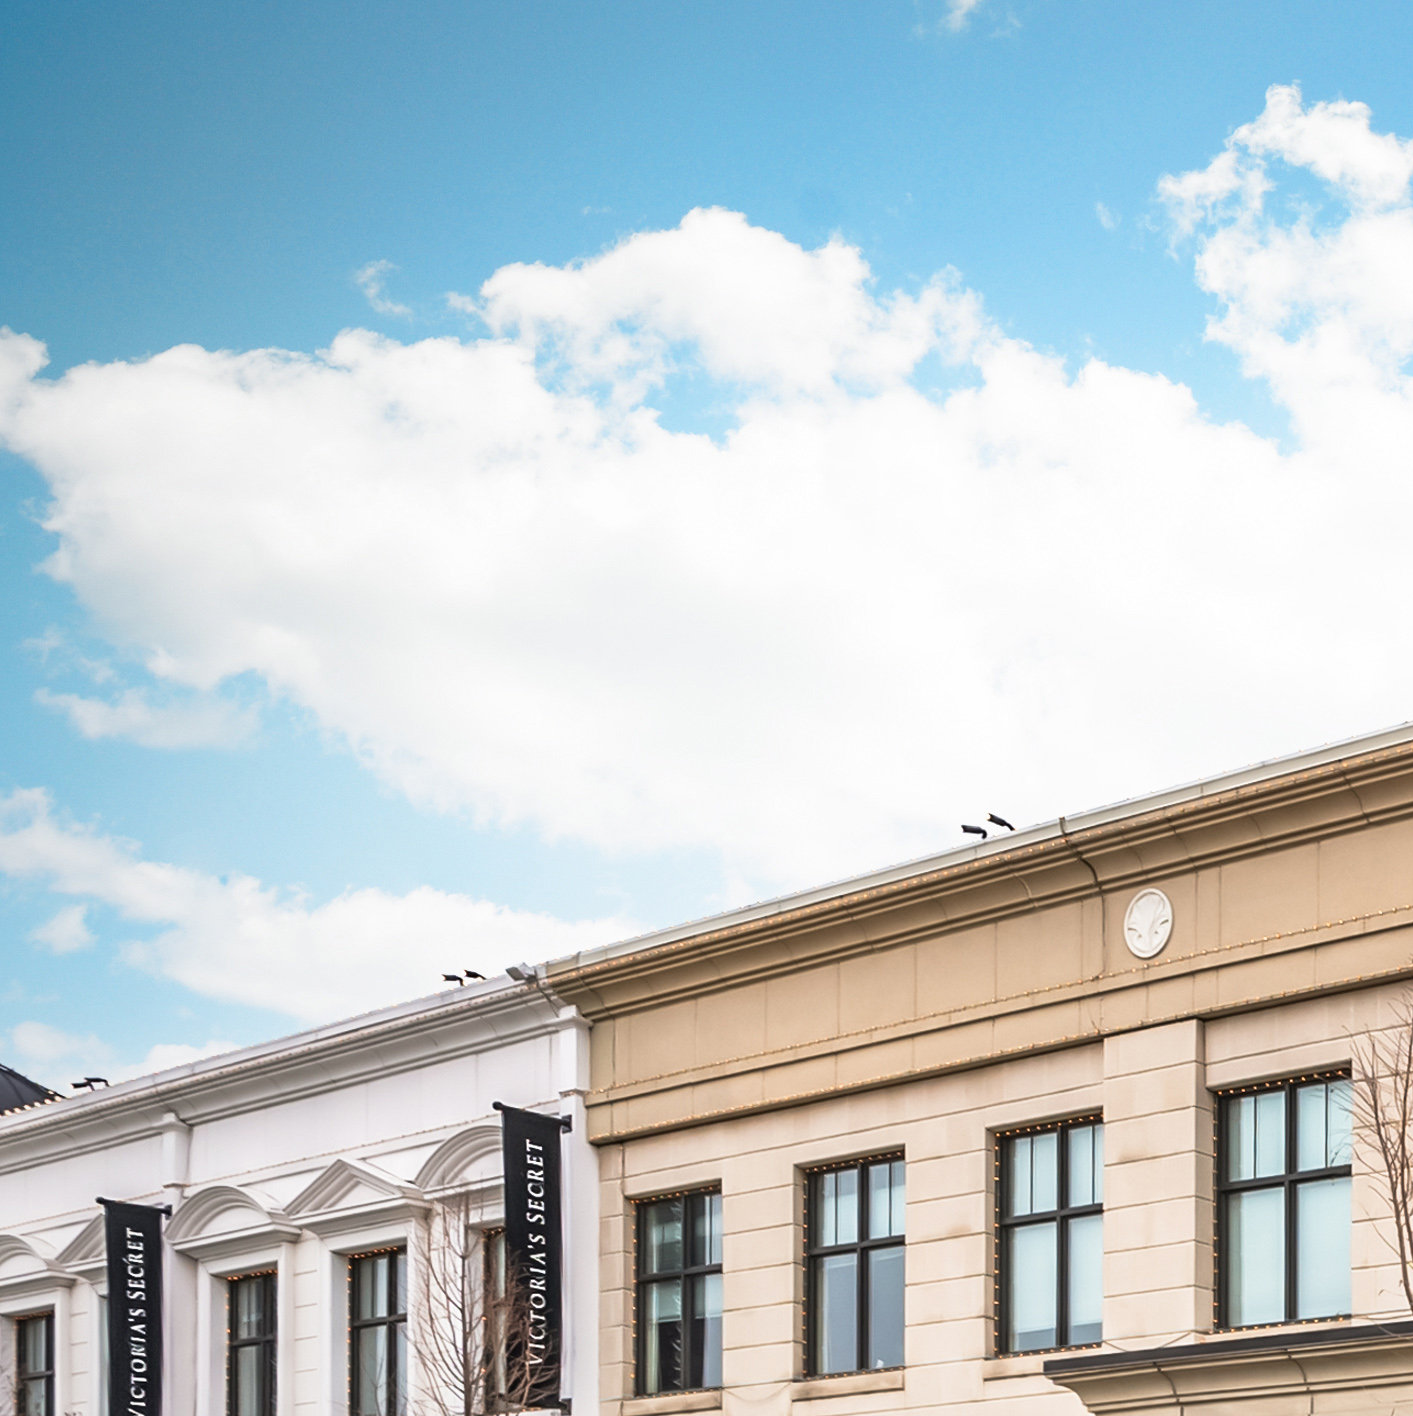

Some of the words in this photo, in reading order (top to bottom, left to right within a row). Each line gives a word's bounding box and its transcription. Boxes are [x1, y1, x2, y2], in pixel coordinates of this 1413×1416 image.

[525, 1139, 546, 1225] SECRET
[125, 1227, 147, 1300] SECRET
[526, 1232, 547, 1366] VICTORIA'S
